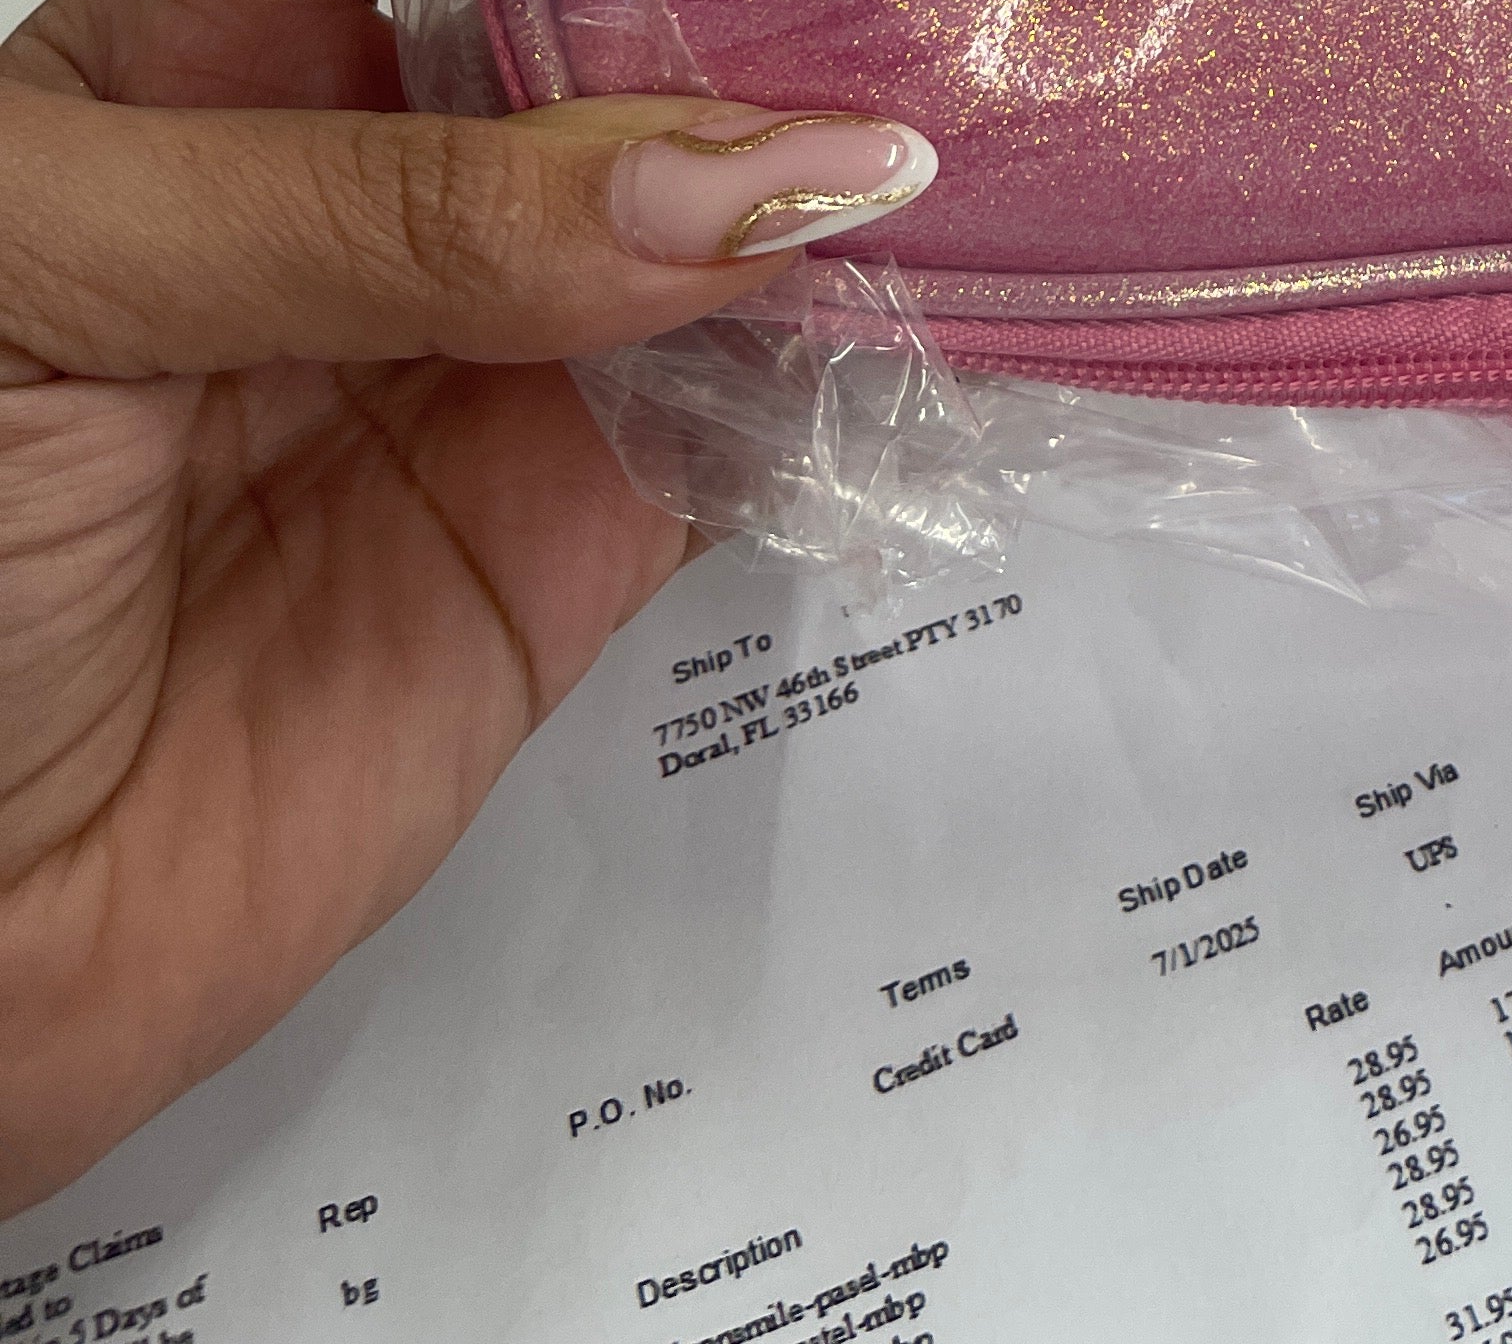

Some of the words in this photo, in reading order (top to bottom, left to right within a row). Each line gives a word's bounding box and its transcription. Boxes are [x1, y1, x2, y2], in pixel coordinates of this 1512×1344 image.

[653, 706, 717, 746] 7750
[722, 684, 770, 723] NW
[775, 666, 832, 699] 46th
[833, 639, 905, 677] Street
[902, 615, 959, 653] PTY
[965, 593, 1023, 632] 3170
[673, 648, 733, 684] Ship
[734, 633, 772, 658] To
[658, 732, 740, 779] Doral,
[742, 715, 780, 747] FL
[785, 682, 860, 729] 33166
[1354, 782, 1413, 818] Ship
[1413, 762, 1460, 791] Via
[1118, 876, 1181, 914] Ship
[1181, 848, 1249, 890] Date
[1403, 835, 1458, 873] UPS
[1151, 915, 1260, 977] 7/1/2025
[879, 957, 972, 1009] Terms
[1305, 990, 1370, 1031] Rate
[873, 1044, 954, 1095] Credit
[956, 1012, 1019, 1058] Card
[1347, 1034, 1419, 1086] 28.95
[569, 1096, 636, 1137] P.O.
[643, 1076, 693, 1110] No.
[1360, 1068, 1432, 1119] 28.95
[1373, 1104, 1446, 1156] 26.95
[1387, 1139, 1460, 1191] 28.95
[318, 1195, 379, 1233] Rep
[1401, 1175, 1475, 1229] 28.95
[1415, 1211, 1489, 1265] 26.95
[636, 1227, 803, 1309] Description
[92, 1297, 168, 1341] Days
[176, 1272, 210, 1309] of
